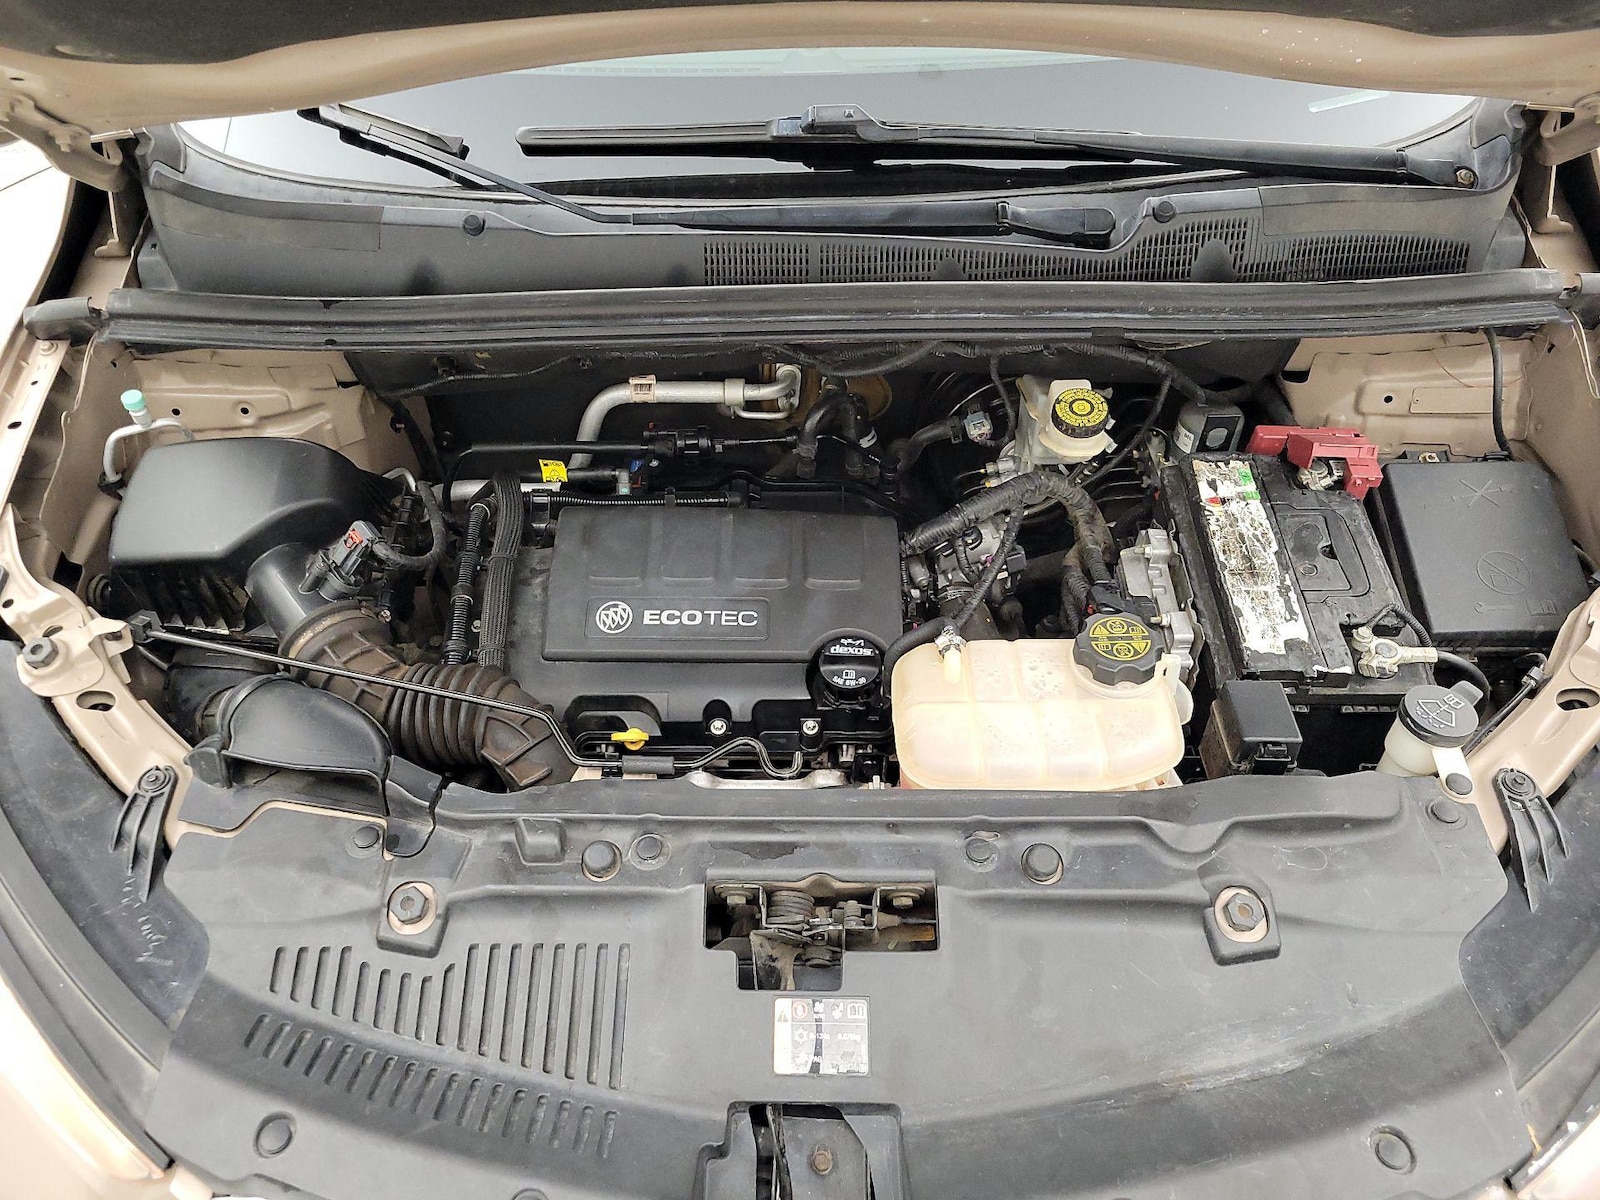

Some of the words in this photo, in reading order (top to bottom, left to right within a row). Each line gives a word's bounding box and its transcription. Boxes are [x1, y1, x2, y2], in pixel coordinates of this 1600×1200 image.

[642, 609, 759, 627] ECOTEC
[830, 645, 873, 655] dexos
[832, 676, 845, 685] SAE
